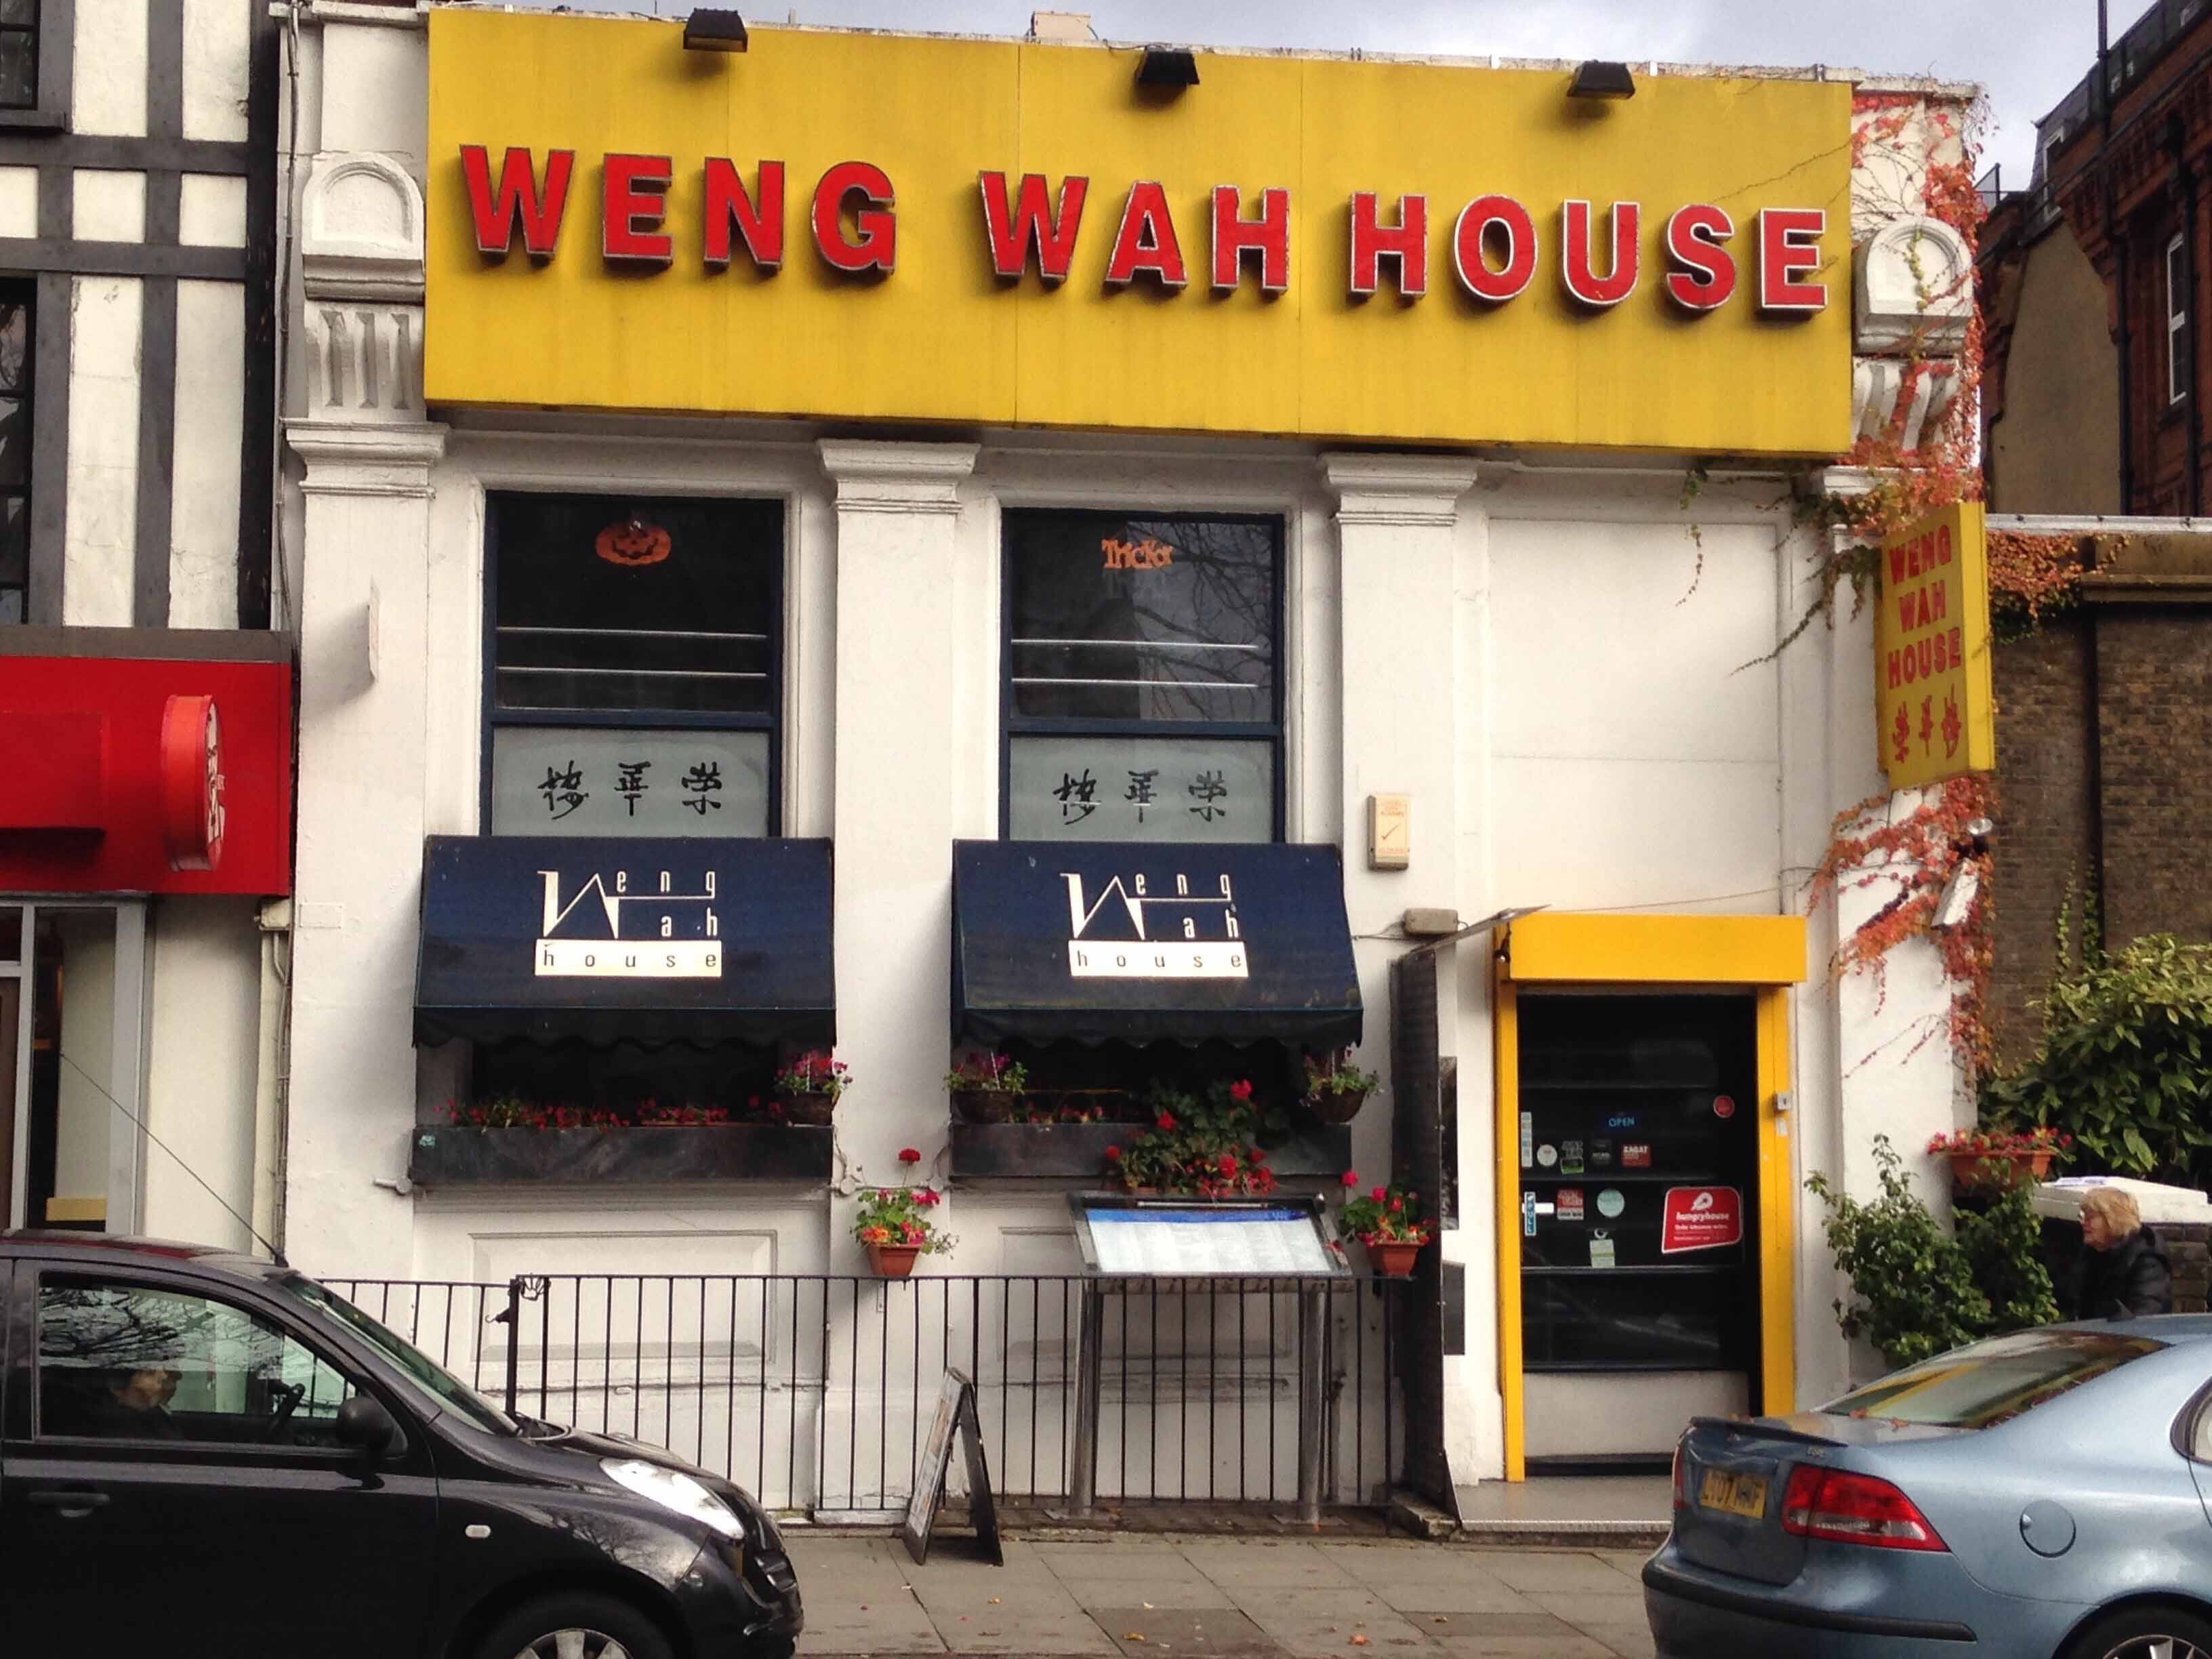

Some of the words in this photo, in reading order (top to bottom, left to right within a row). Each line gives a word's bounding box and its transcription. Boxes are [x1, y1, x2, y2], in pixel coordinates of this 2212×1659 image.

[459, 144, 896, 272] WENG
[979, 170, 1290, 291] WAH
[1349, 190, 1828, 310] HOUSE
[1889, 524, 1952, 586] WENG
[1898, 579, 1946, 633] WAH
[1887, 626, 1961, 689] HOUSE
[543, 950, 717, 968] house
[1076, 950, 1242, 968] house
[1608, 1117, 1635, 1127] OPEN
[1676, 1212, 1729, 1222] hungryhouse
